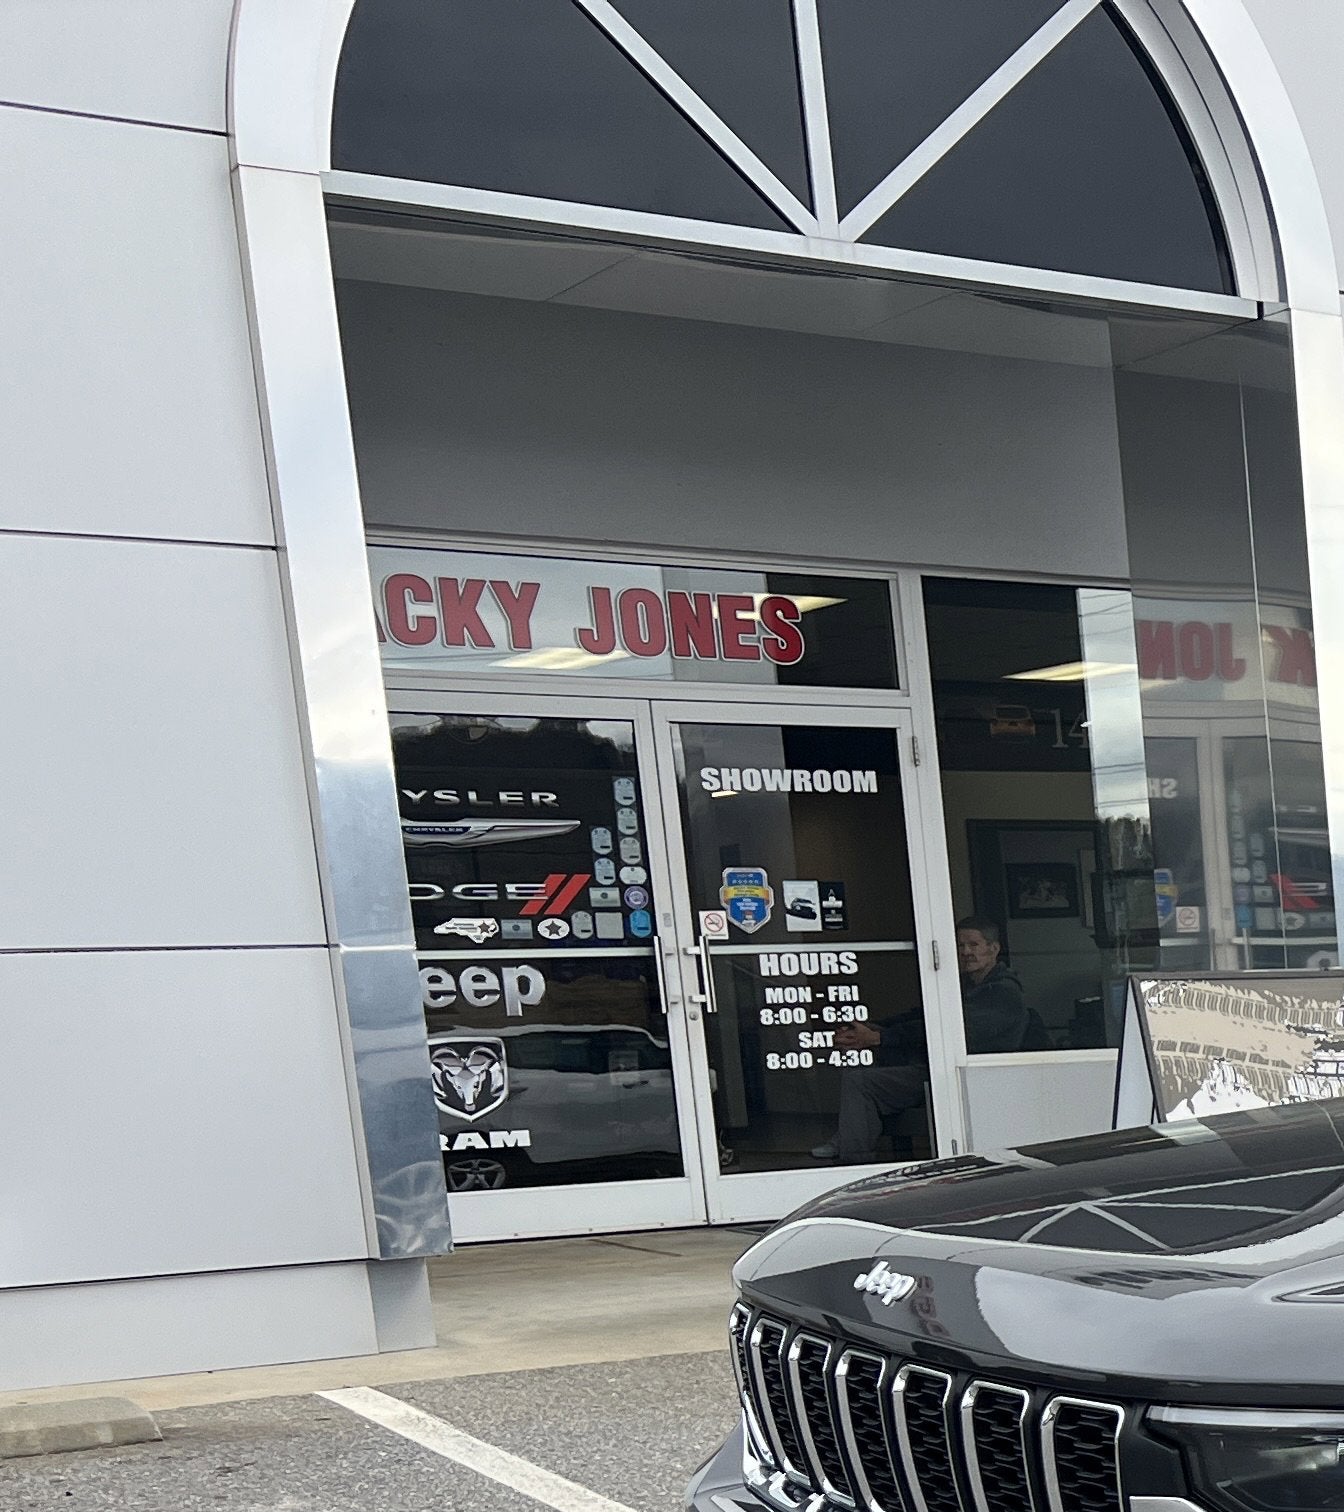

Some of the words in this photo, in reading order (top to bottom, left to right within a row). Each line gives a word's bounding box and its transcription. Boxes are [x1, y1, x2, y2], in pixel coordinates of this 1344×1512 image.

[378, 573, 541, 652] CKY
[574, 586, 806, 666] JONES
[701, 767, 878, 793] SHOWROOM
[401, 789, 560, 807] YSLER
[407, 883, 549, 900] DGE
[759, 952, 859, 977] HOURS
[418, 964, 547, 1017] eep
[765, 986, 812, 1005] MON
[827, 985, 860, 1002] FRI
[760, 1008, 807, 1026] 8:00
[822, 1005, 869, 1023] 6:30
[798, 1031, 836, 1049] SAT
[766, 1052, 813, 1070] 8:00
[829, 1049, 874, 1068] 4:30
[854, 1261, 917, 1307] Jeep
